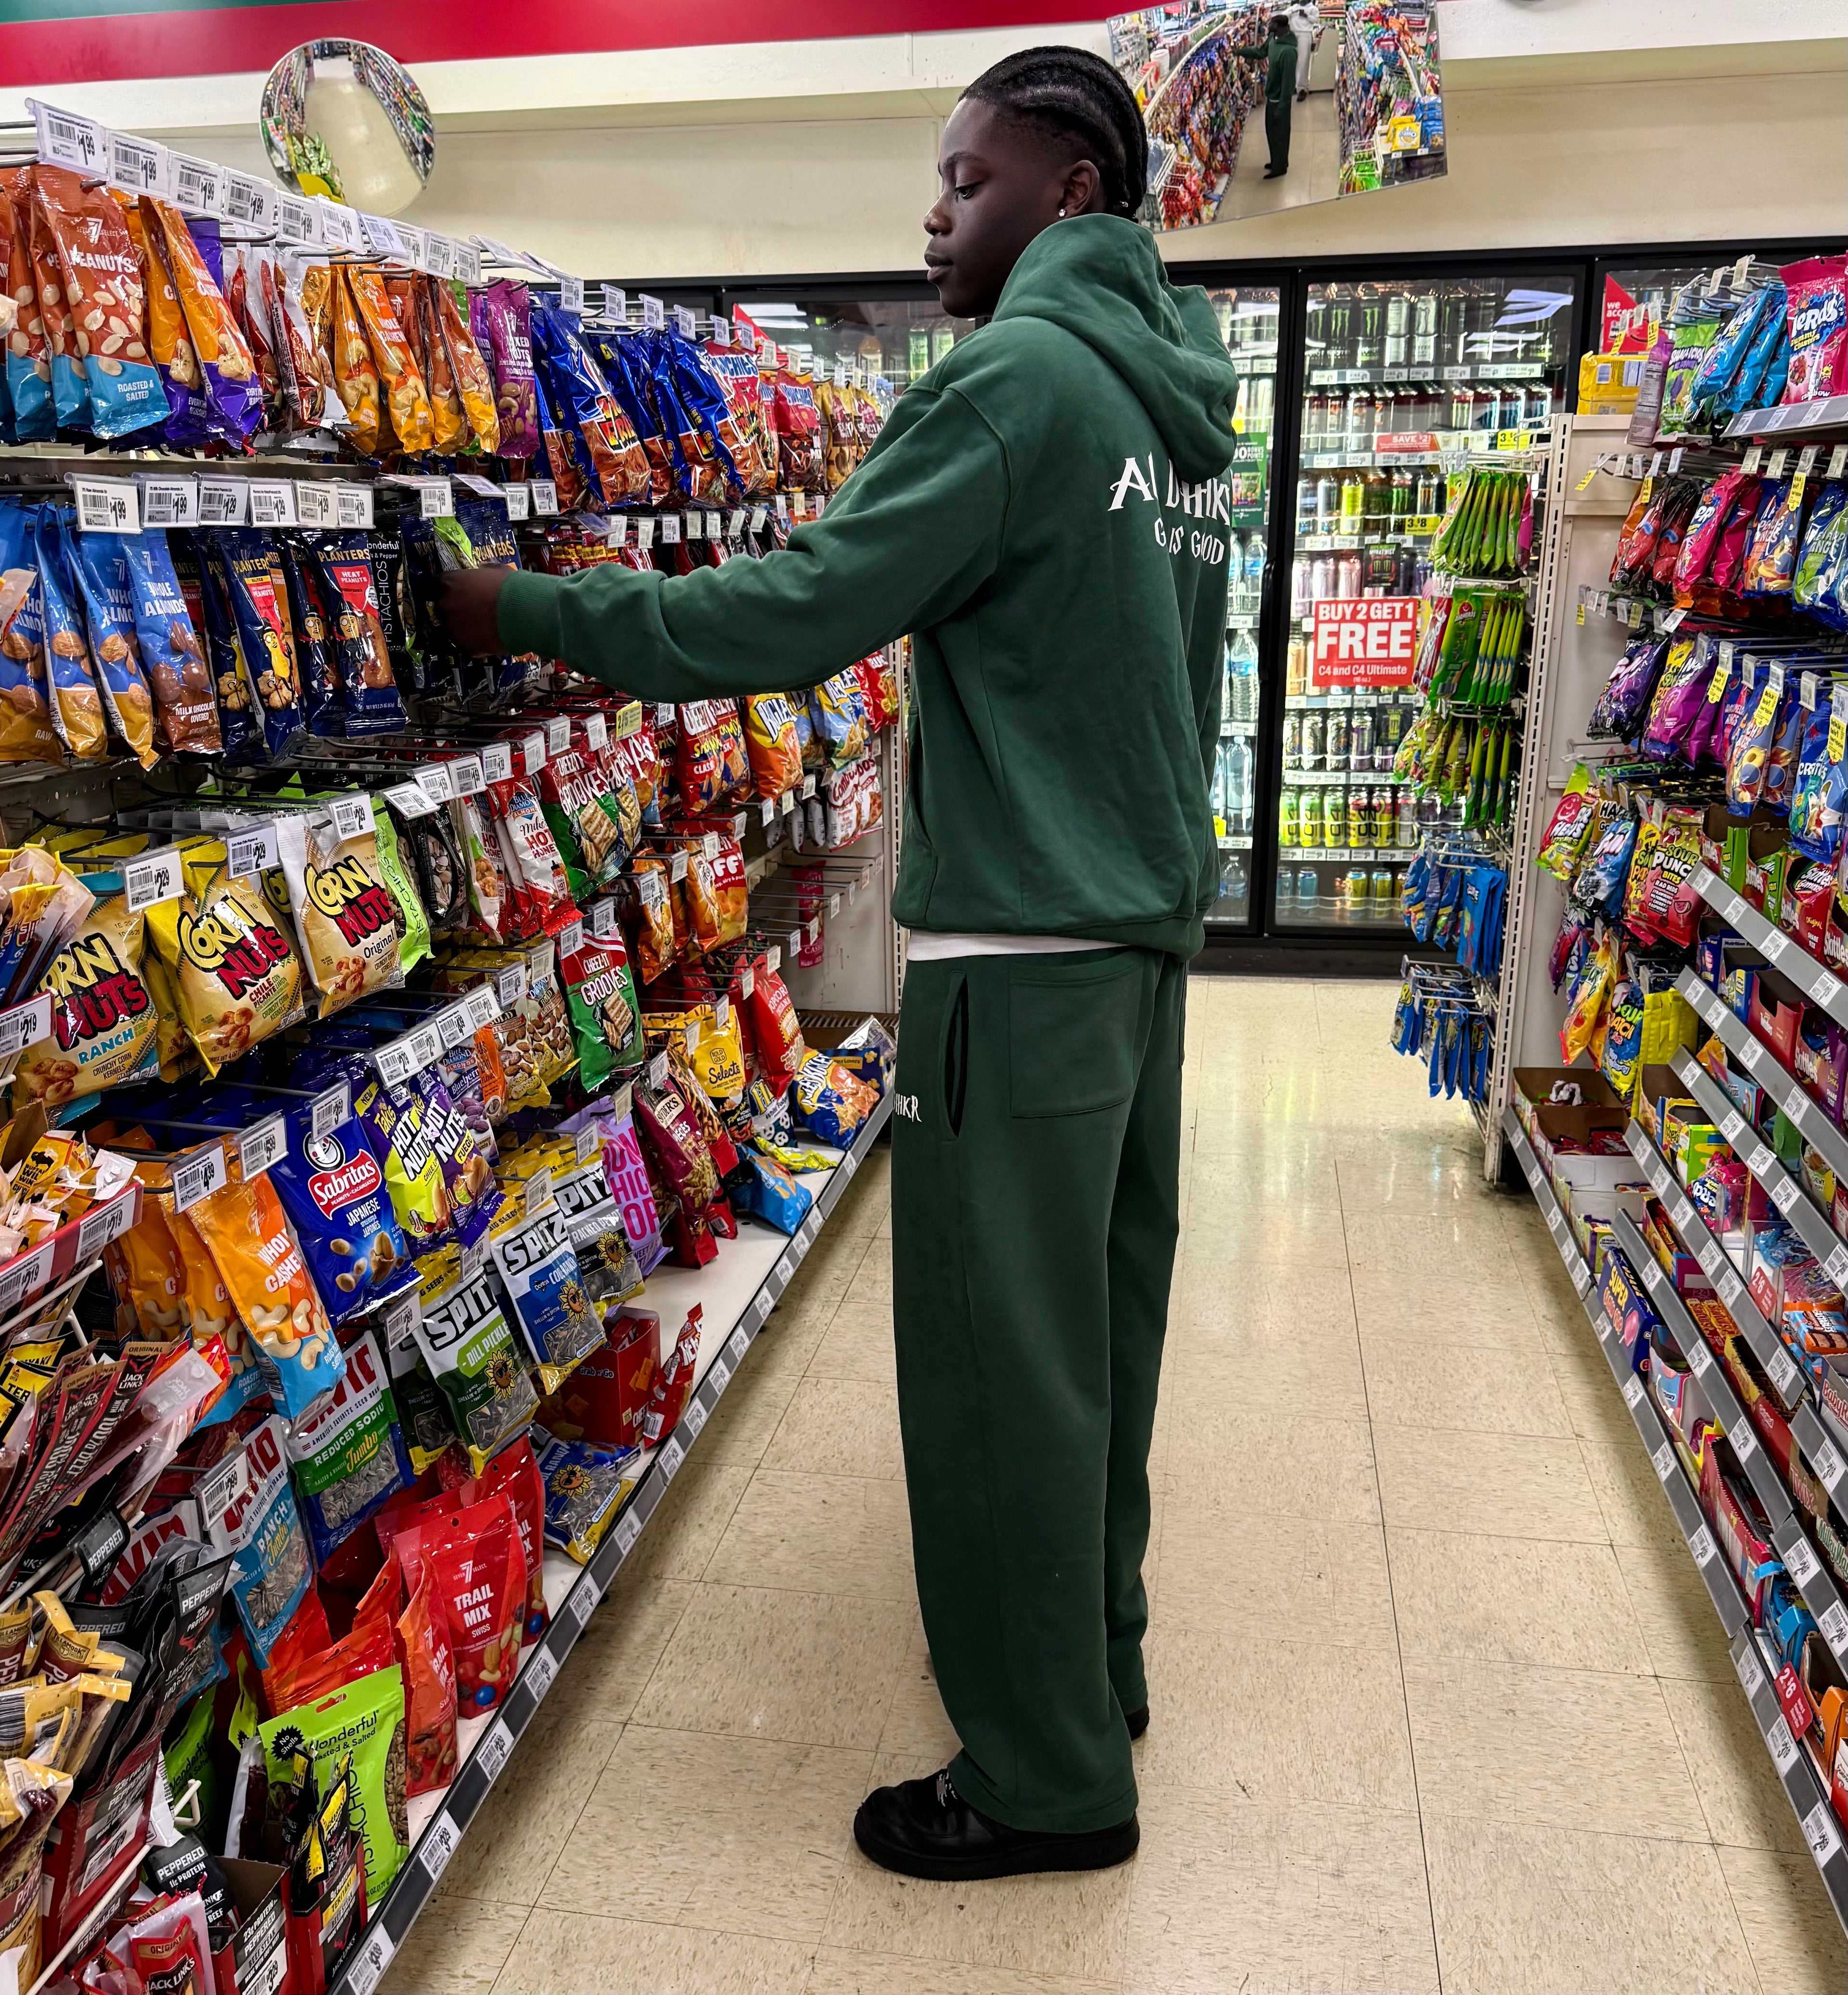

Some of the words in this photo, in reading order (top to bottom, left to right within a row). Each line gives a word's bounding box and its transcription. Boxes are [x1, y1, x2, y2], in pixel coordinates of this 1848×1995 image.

[117, 380, 147, 393] ROASTED
[126, 390, 149, 401] SALTED
[1392, 435, 1417, 443] SAVE
[318, 549, 370, 562] PLANTERS
[367, 541, 399, 550] onderful
[148, 581, 173, 597] WHOLE
[376, 561, 393, 642] PISTACHIOS
[145, 598, 188, 617] ALMONDS
[1318, 603, 1354, 621] BUY
[1355, 602, 1367, 620] 2
[1369, 602, 1405, 620] GET
[1405, 601, 1413, 619] 1
[1316, 622, 1412, 660] FREE
[1318, 665, 1332, 677] C4
[1332, 665, 1350, 676] and
[1351, 665, 1365, 676] C4
[1366, 664, 1408, 676] Ultimate
[175, 706, 193, 716] MILK
[190, 712, 209, 724] COVERED
[35, 729, 53, 742] RAW
[1652, 851, 1692, 877] PUNC
[305, 858, 373, 916] CORN
[1662, 871, 1681, 884] BITES
[334, 887, 394, 946] NUTS
[178, 895, 254, 969] CORN
[363, 934, 395, 959] Original
[216, 925, 288, 999] NUTS
[249, 978, 274, 1004] CHILE
[580, 965, 629, 1007] GROOVES
[54, 972, 148, 1051] NUTS
[253, 989, 277, 1010] PICANTE
[77, 1028, 135, 1065] RANCH
[92, 1055, 117, 1077] CRUNCHY
[114, 1050, 133, 1065] CORN
[103, 1063, 127, 1080] KERNELS
[708, 1061, 741, 1084] Selects
[361, 1089, 372, 1105] NEW
[435, 1108, 465, 1163] NUTS
[457, 1138, 474, 1161] FUEGO
[313, 1161, 376, 1205] Sabritas
[346, 1197, 381, 1227] JAPANESE
[500, 1208, 517, 1225] SEEDS
[503, 1212, 570, 1275] SPITZ
[425, 1274, 445, 1292] SEEDS
[1608, 1266, 1628, 1311] SUPER
[425, 1280, 497, 1349] SPIT
[466, 1348, 484, 1367] DILL
[485, 1323, 511, 1354] PICKLE
[579, 1366, 596, 1376] Grab
[354, 1396, 368, 1409] SEED
[314, 1427, 355, 1467] REDUCED
[356, 1402, 385, 1431] SODIU
[346, 1431, 378, 1472] Jumbo
[257, 1501, 288, 1554] RANCH
[88, 1528, 124, 1571] PEPPERED
[182, 1574, 224, 1613] PEPPERED
[453, 1583, 494, 1611] TRAIL
[463, 1603, 492, 1628] MIX
[471, 1624, 490, 1638] SWISS
[279, 1734, 290, 1746] No
[281, 1736, 298, 1755] Shells
[351, 1728, 376, 1748] Salted
[156, 1845, 205, 1880] PEPPERED
[177, 1861, 206, 1884] PROTEIN
[331, 1877, 352, 1912] TERIYAKI
[207, 1907, 224, 1924] BEEF
[254, 1902, 275, 1932] PROTEIN
[244, 1910, 276, 1957] PEPPERED
